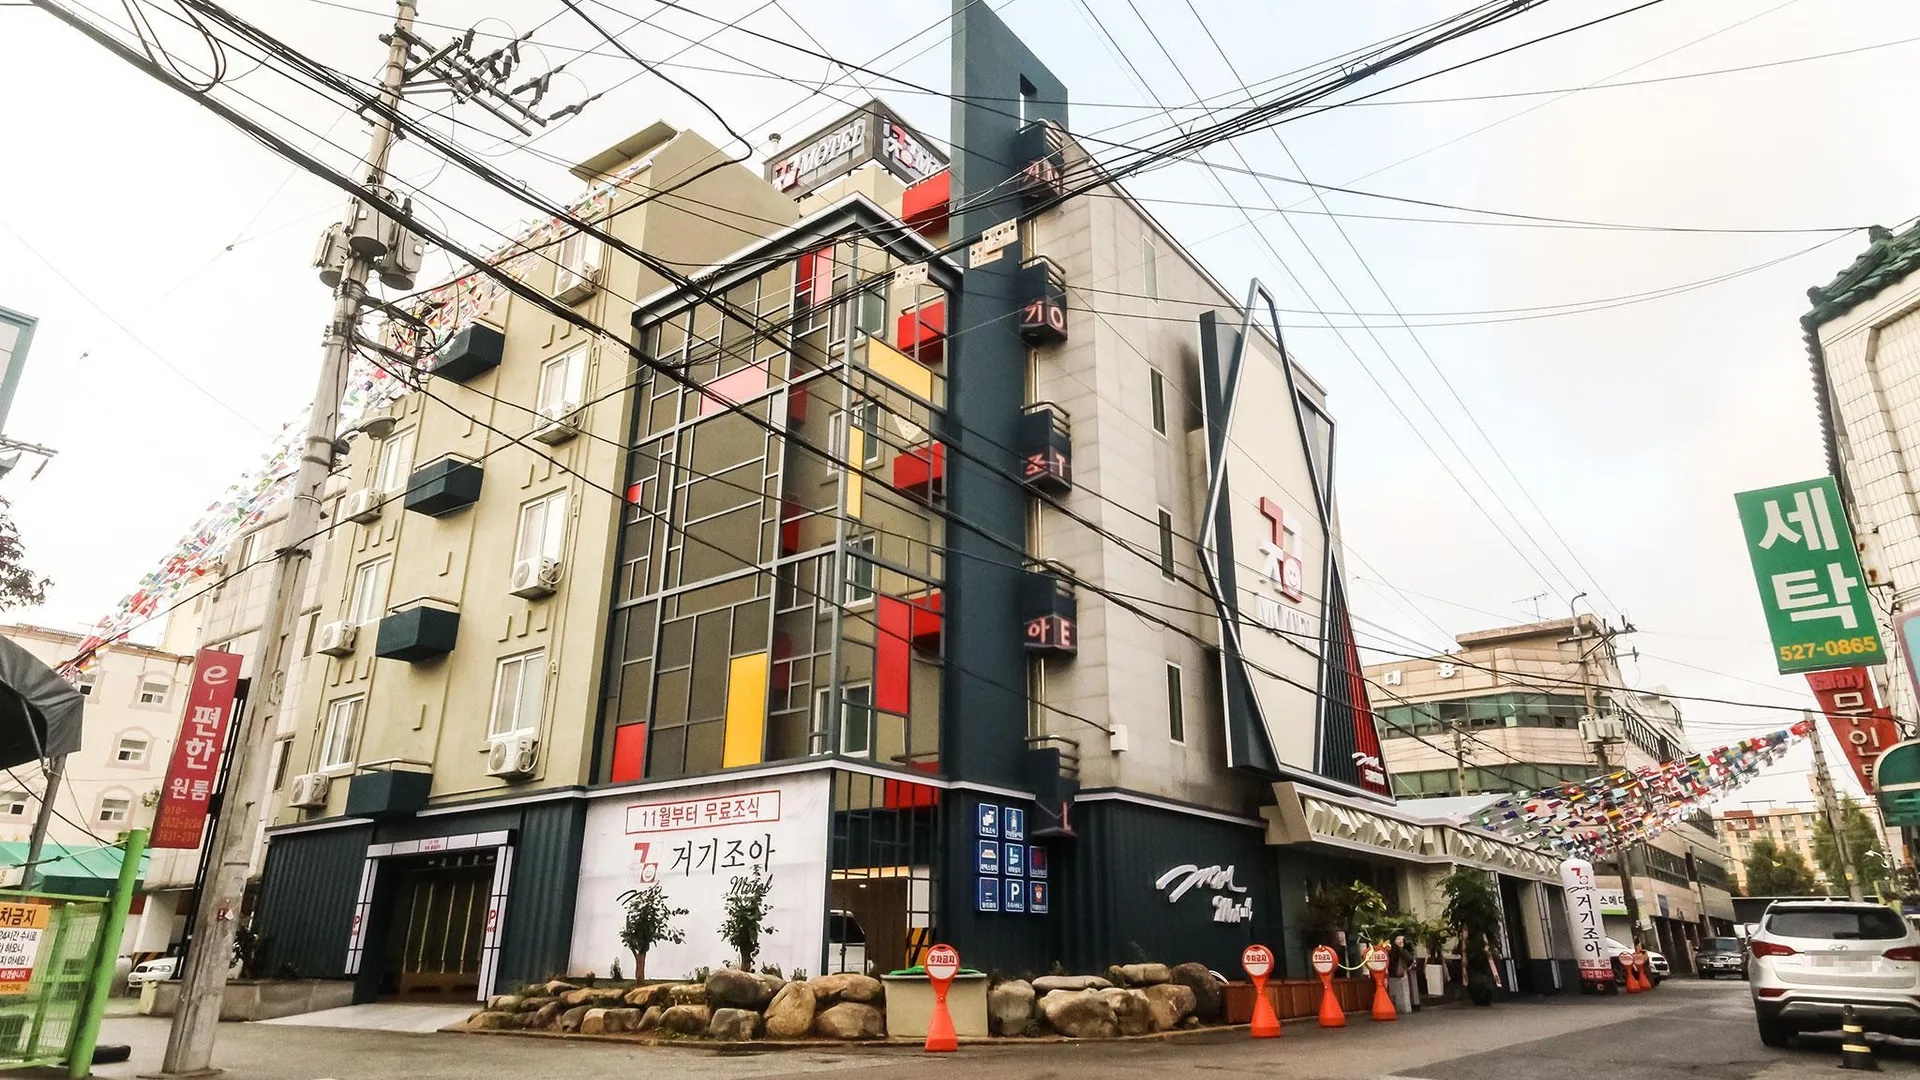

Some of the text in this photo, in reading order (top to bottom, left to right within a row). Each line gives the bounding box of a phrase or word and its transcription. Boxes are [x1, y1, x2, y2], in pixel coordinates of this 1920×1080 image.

[799, 124, 865, 174] MOTEL
[1758, 486, 1858, 630] 세탁
[1780, 636, 1878, 661] 527-0865
[170, 777, 210, 801] 원룸
[642, 796, 760, 828] 11월부터 무료조식
[670, 833, 776, 877] 거기조아
[1576, 893, 1603, 958] 거기조아
[930, 954, 955, 964] 주차금지
